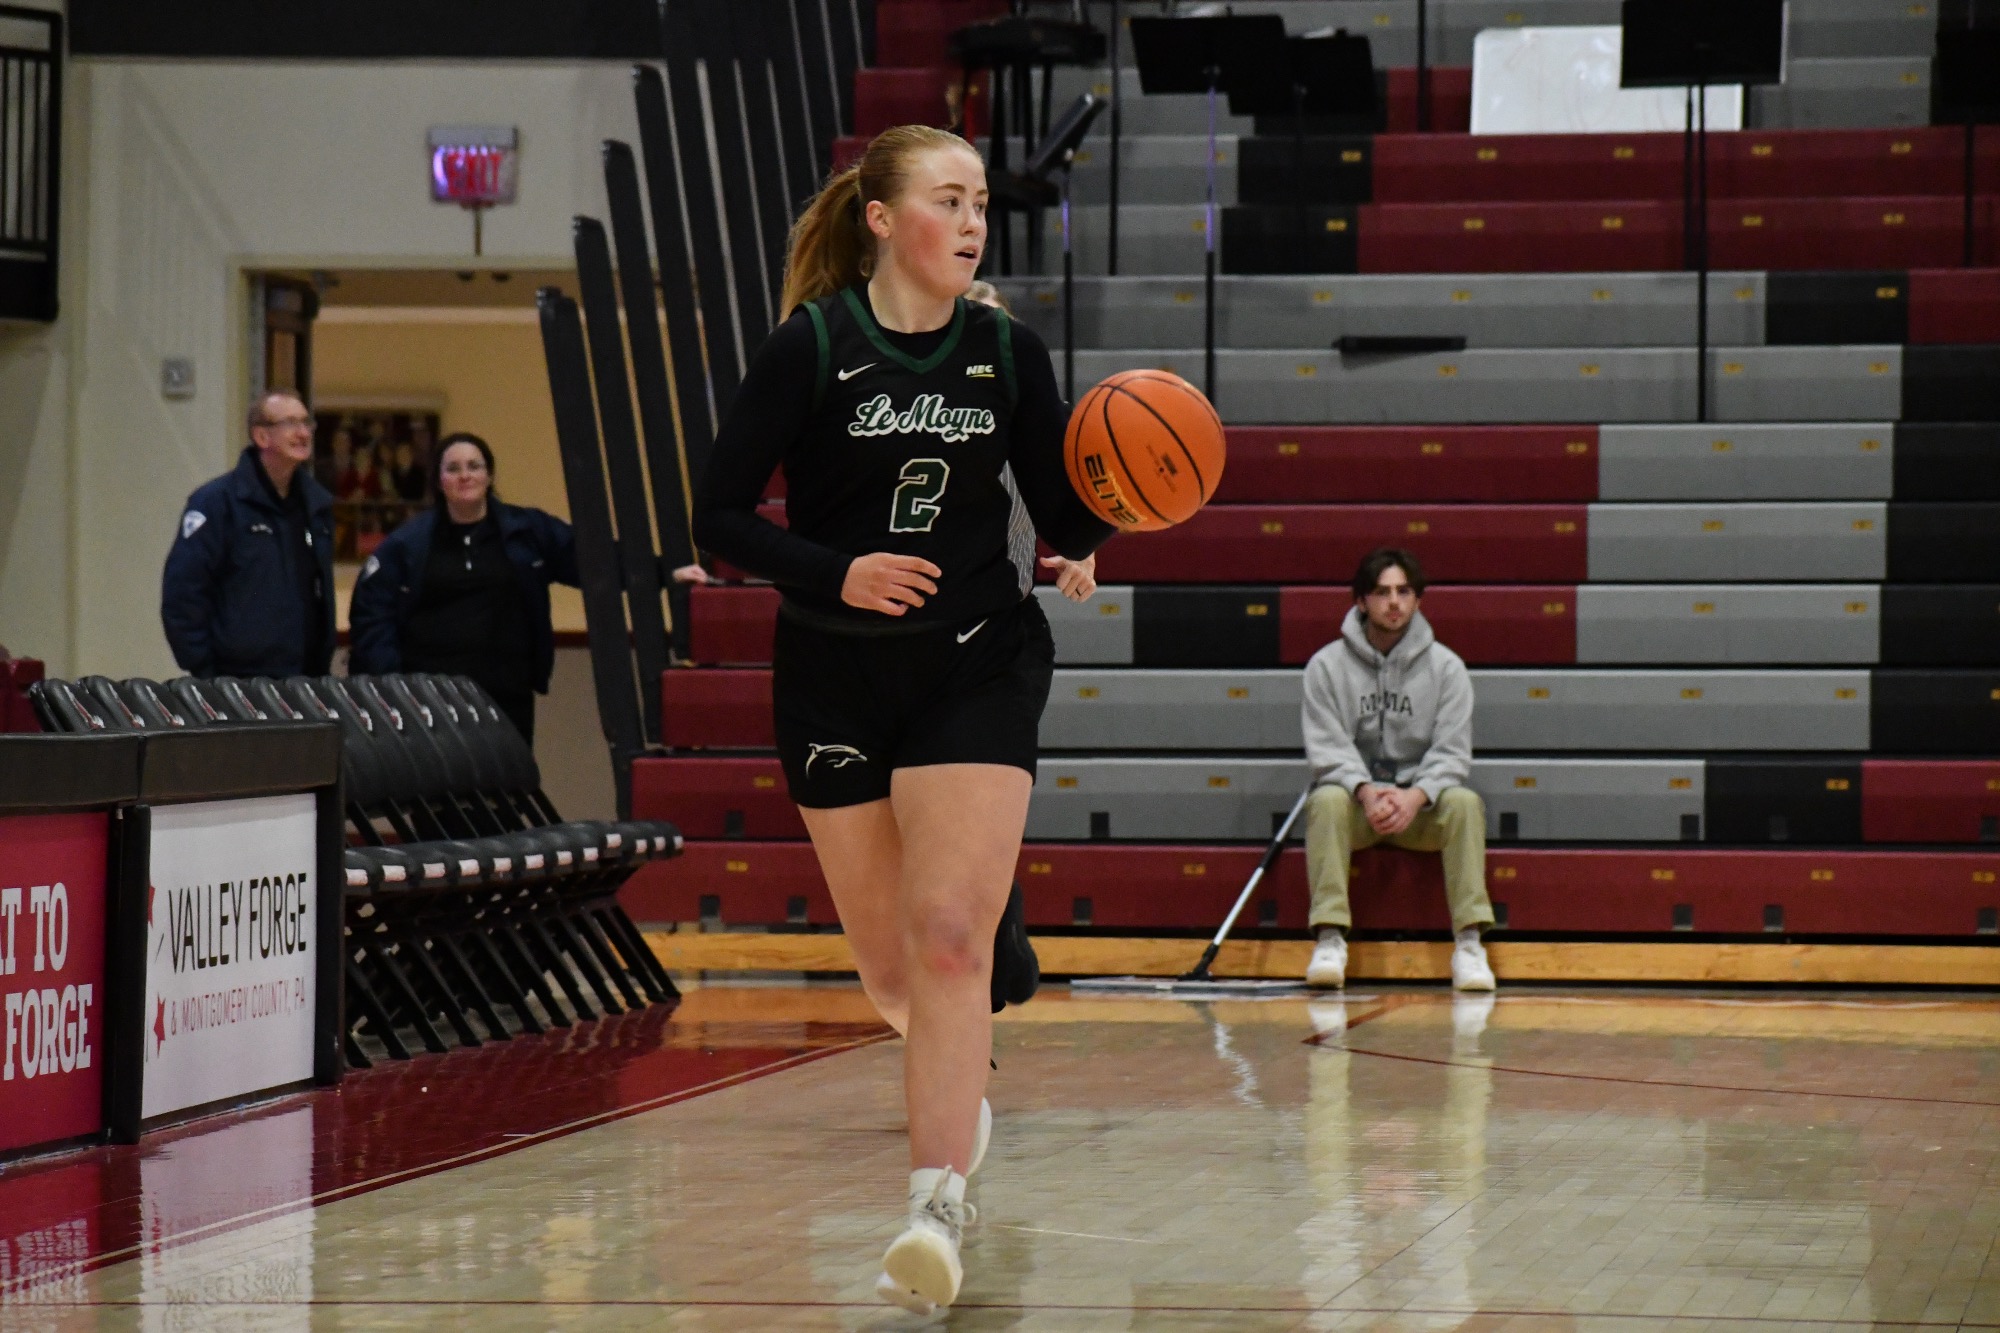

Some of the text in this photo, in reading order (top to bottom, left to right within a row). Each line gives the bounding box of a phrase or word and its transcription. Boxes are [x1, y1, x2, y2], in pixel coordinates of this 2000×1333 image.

[966, 364, 994, 376] NEC
[889, 458, 950, 532] 2
[1084, 453, 1138, 524] ELITE
[0, 882, 69, 976] T TO
[168, 872, 307, 975] VALLEY FORGE
[3, 983, 93, 1081] FORGE
[181, 986, 249, 1034] MONTGOMERY
[295, 976, 305, 1010] PA
